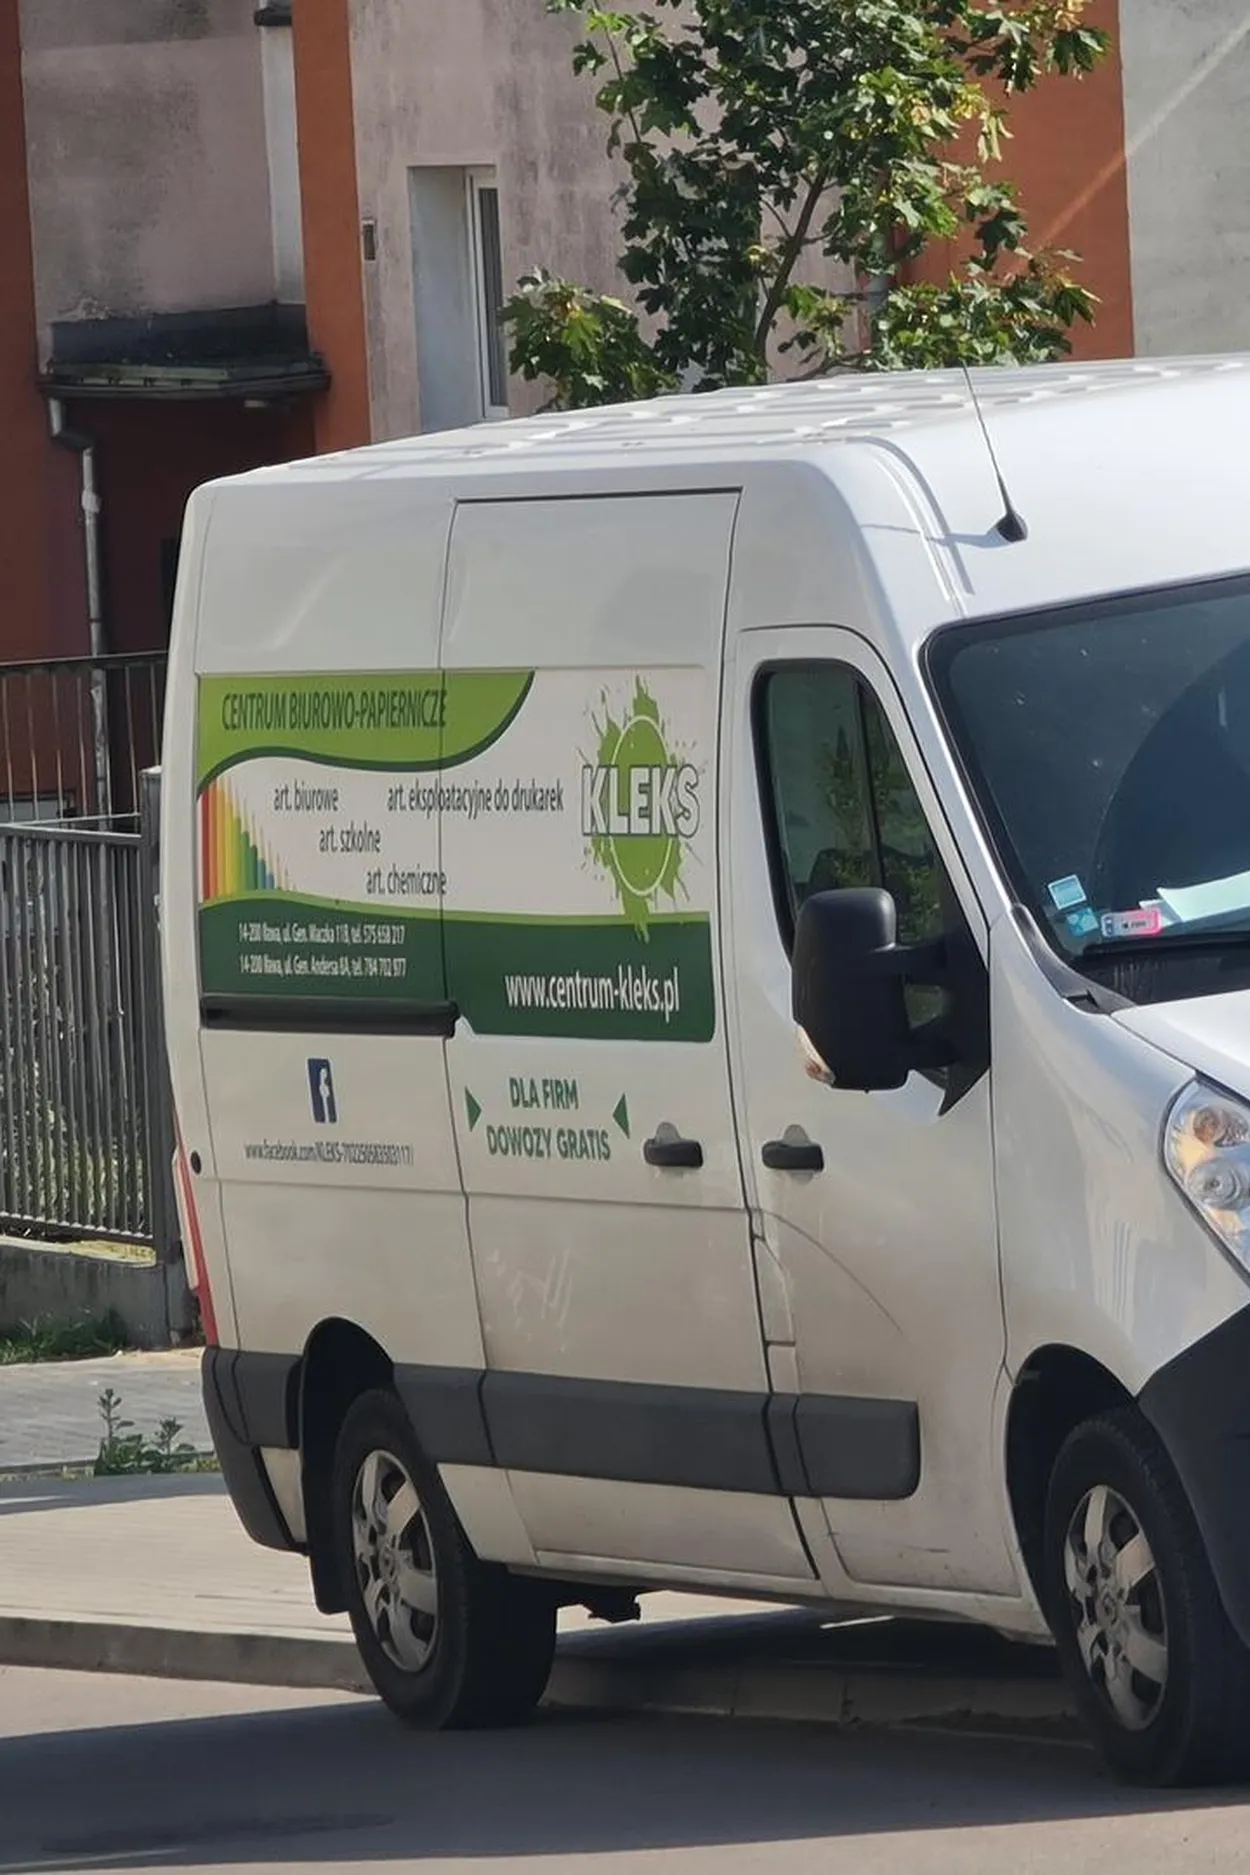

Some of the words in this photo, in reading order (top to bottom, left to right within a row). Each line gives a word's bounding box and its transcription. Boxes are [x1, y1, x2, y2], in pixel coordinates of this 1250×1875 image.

[221, 692, 286, 731] CENTRUM
[289, 689, 448, 730] BIUROWO-PAPIERNICZE
[273, 783, 293, 812] art.
[294, 779, 339, 812] biurowe
[387, 783, 407, 812] art.
[409, 778, 491, 820] eksploatacyjne
[494, 779, 510, 812] do
[511, 778, 564, 812] drukarek
[582, 764, 700, 839] KLEKS
[318, 826, 338, 852] art.
[340, 820, 381, 852] szkolne
[366, 869, 385, 895] art.
[387, 864, 448, 895] chemiczne
[505, 964, 680, 1024] www.centrum-kleks.pl
[508, 1077, 541, 1109] DLA
[542, 1079, 579, 1110] FIRM
[486, 1125, 551, 1158] DOWOZY
[556, 1127, 611, 1161] GRATIS
